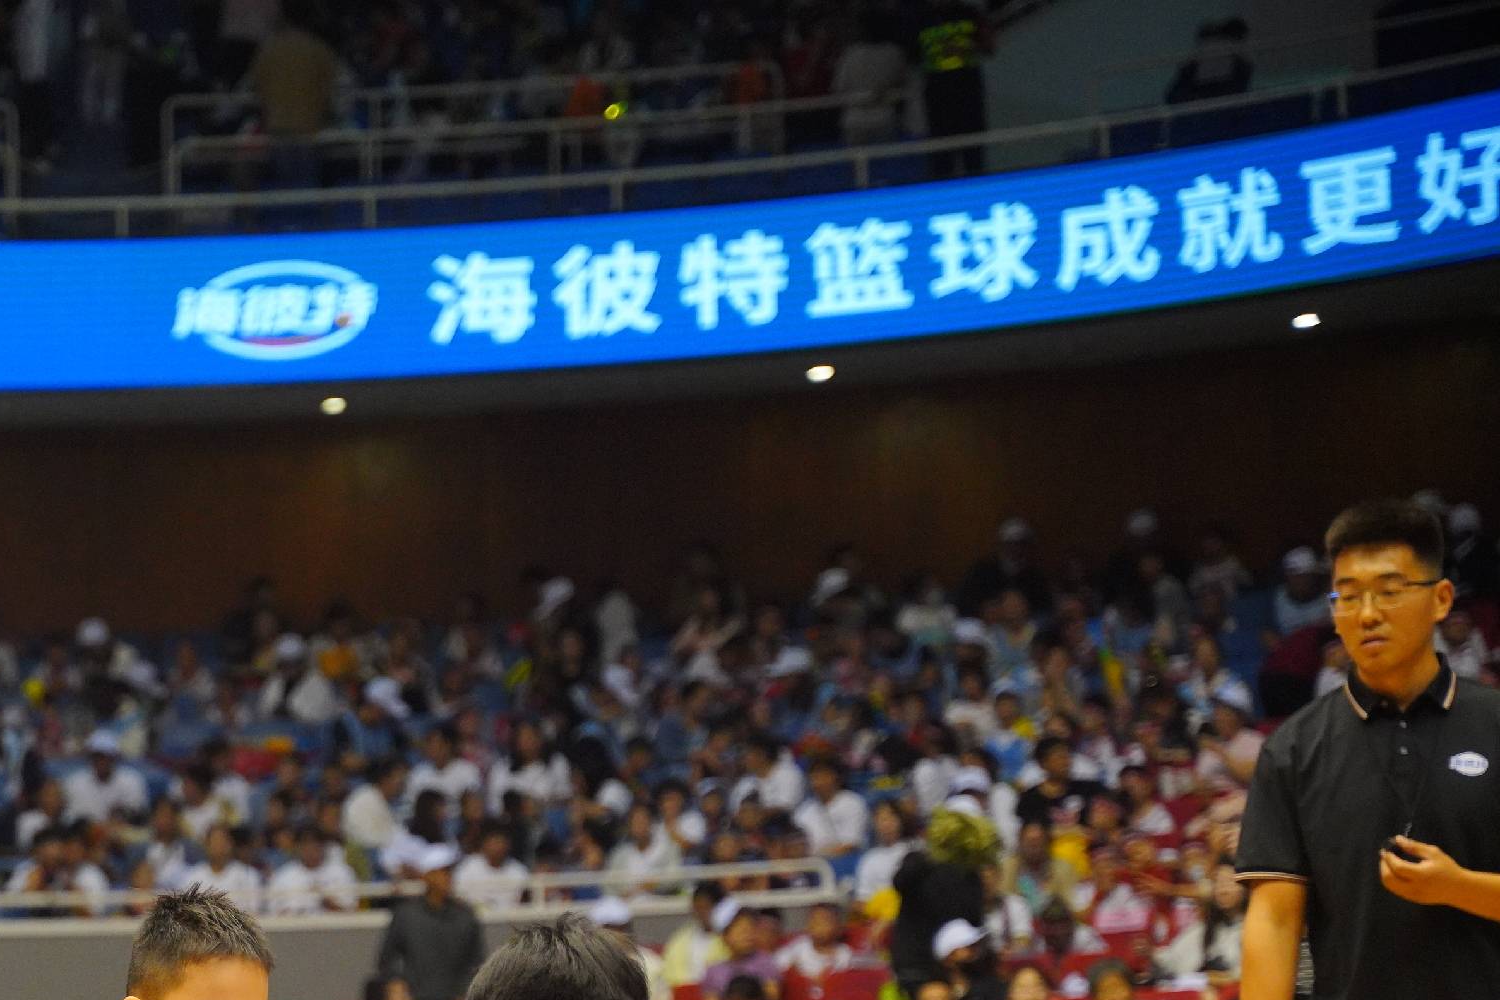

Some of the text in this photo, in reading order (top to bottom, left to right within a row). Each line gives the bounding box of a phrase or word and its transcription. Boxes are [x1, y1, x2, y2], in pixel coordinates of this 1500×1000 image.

[427, 126, 1500, 345] 海彼特篮球成就更好
